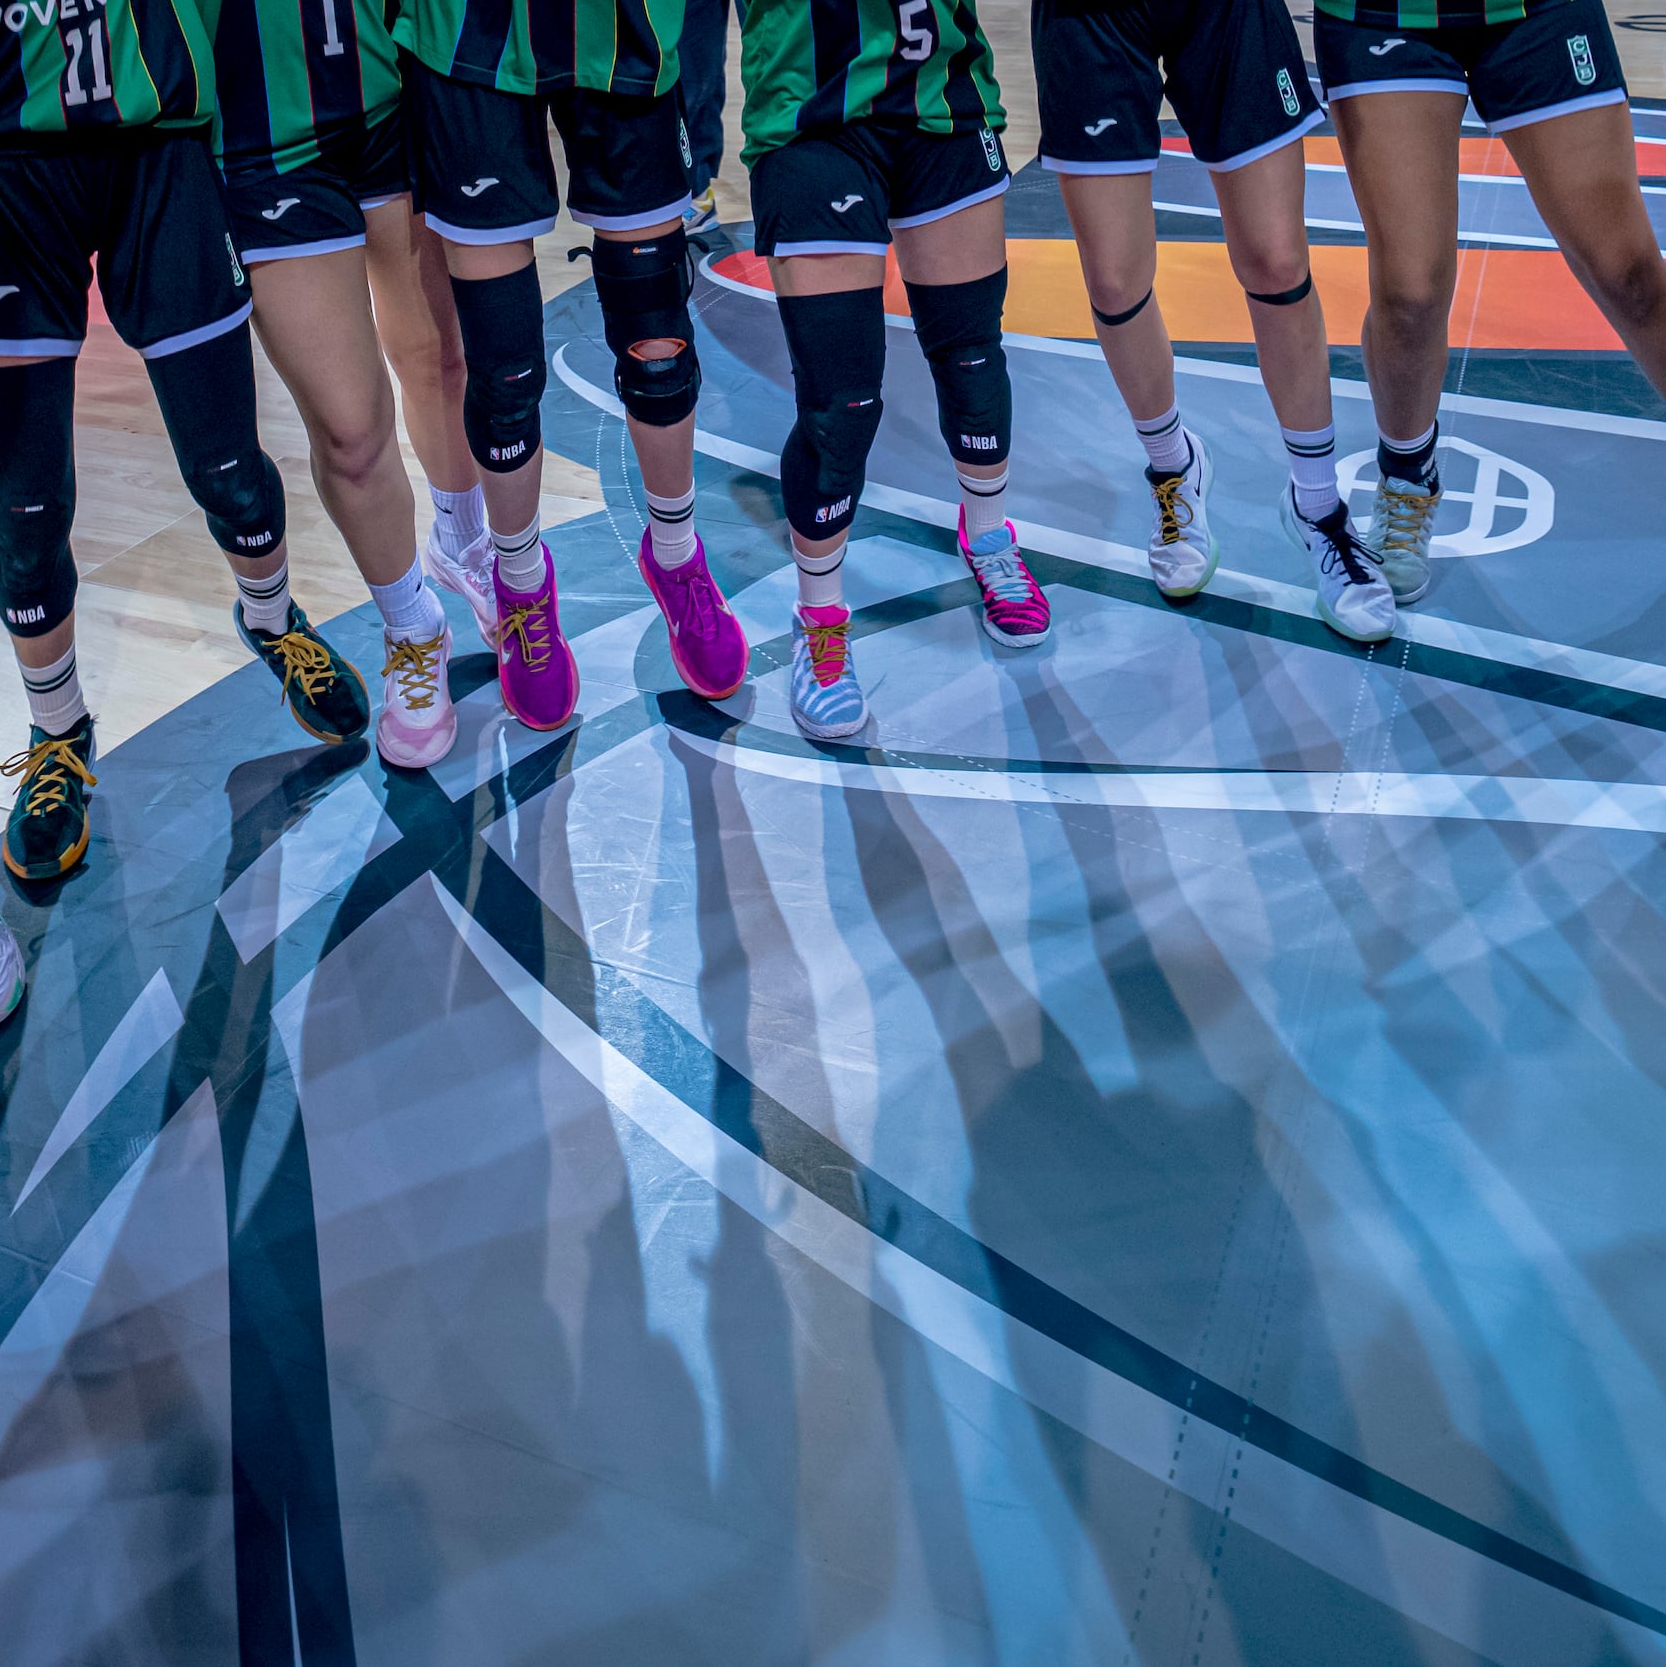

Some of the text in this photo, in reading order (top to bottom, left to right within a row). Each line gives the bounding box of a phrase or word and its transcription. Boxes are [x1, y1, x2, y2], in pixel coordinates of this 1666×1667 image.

[64, 19, 113, 107] 11
[501, 440, 526, 461] NBA
[972, 435, 998, 450] NBA
[828, 495, 852, 521] NBA
[247, 530, 273, 547] NBA
[17, 605, 46, 625] NBA
